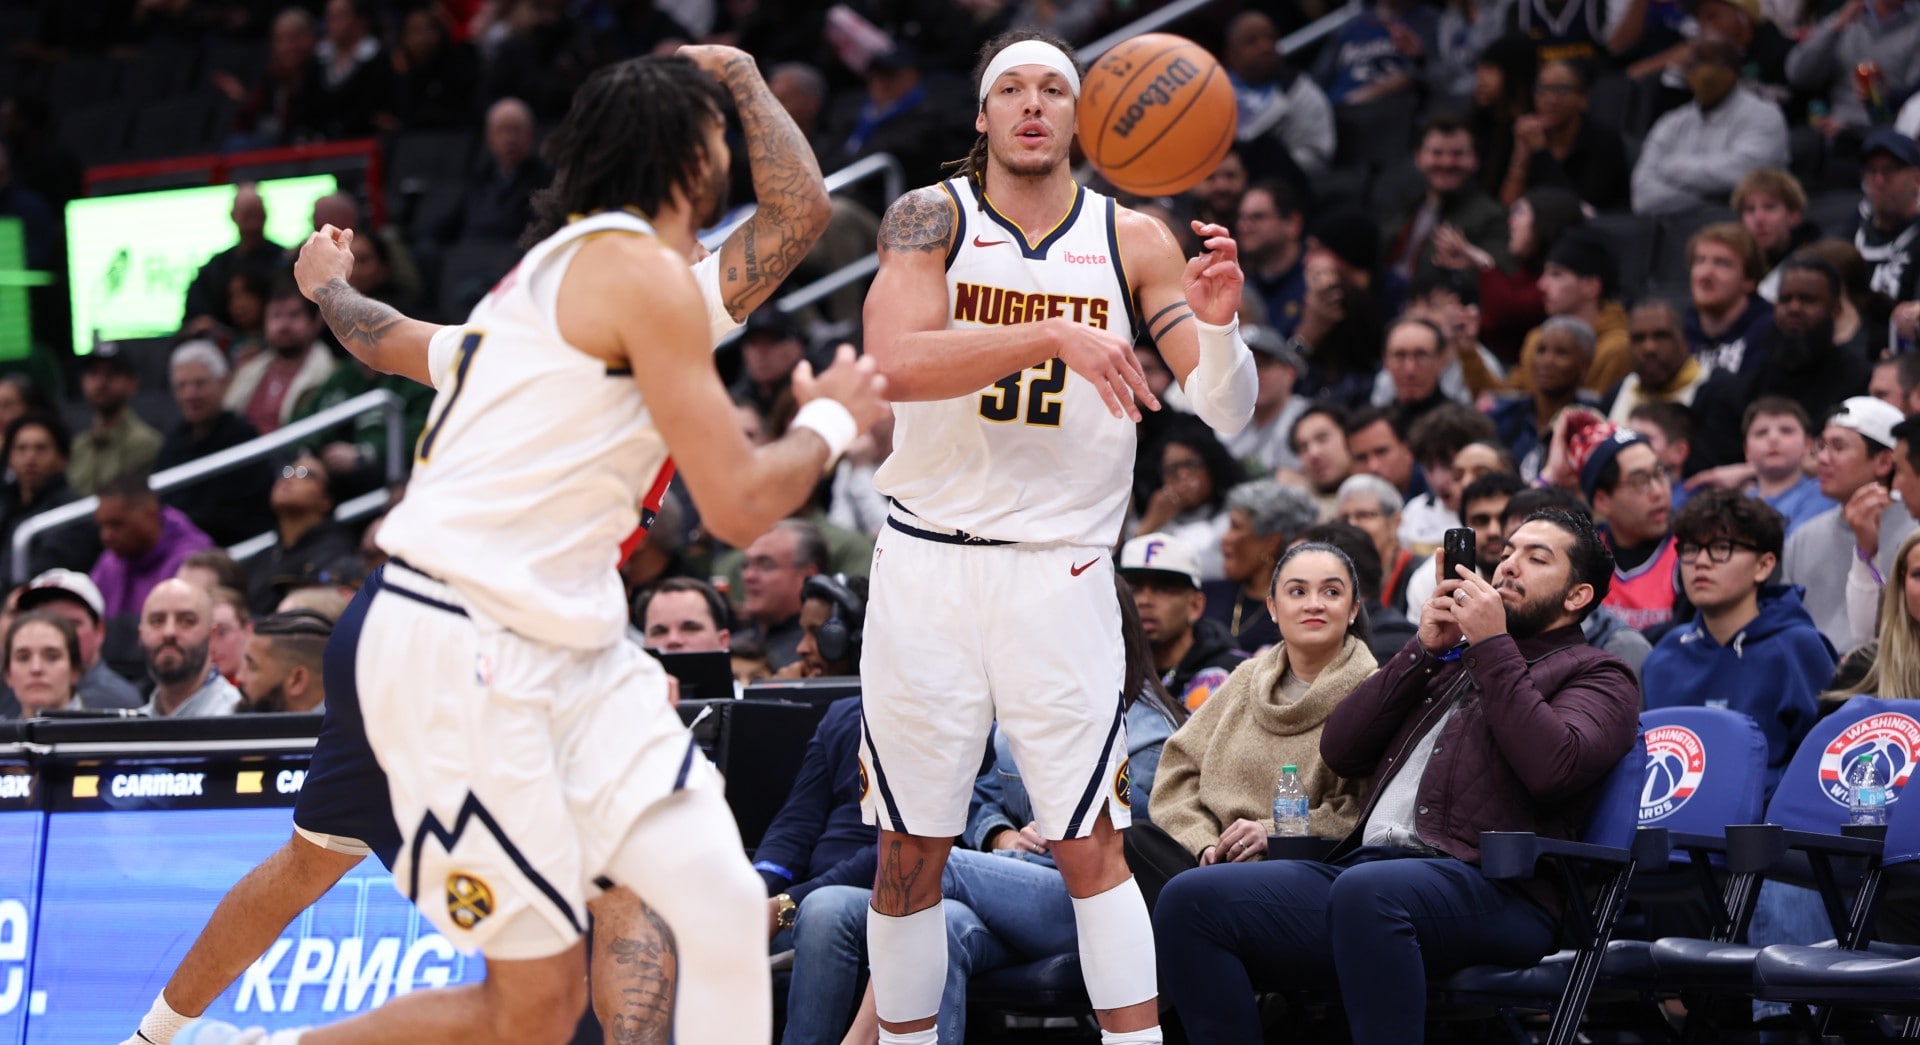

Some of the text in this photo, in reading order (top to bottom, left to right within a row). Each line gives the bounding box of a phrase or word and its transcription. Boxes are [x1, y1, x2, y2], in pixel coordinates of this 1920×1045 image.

[1113, 56, 1200, 138] Wilson
[1063, 251, 1107, 264] ibotta
[954, 282, 1109, 330] NUGGETS
[978, 357, 1069, 428] 32
[1145, 541, 1165, 565] F
[1846, 716, 1920, 746] WASHINGTON
[233, 934, 455, 1013] KPMG
